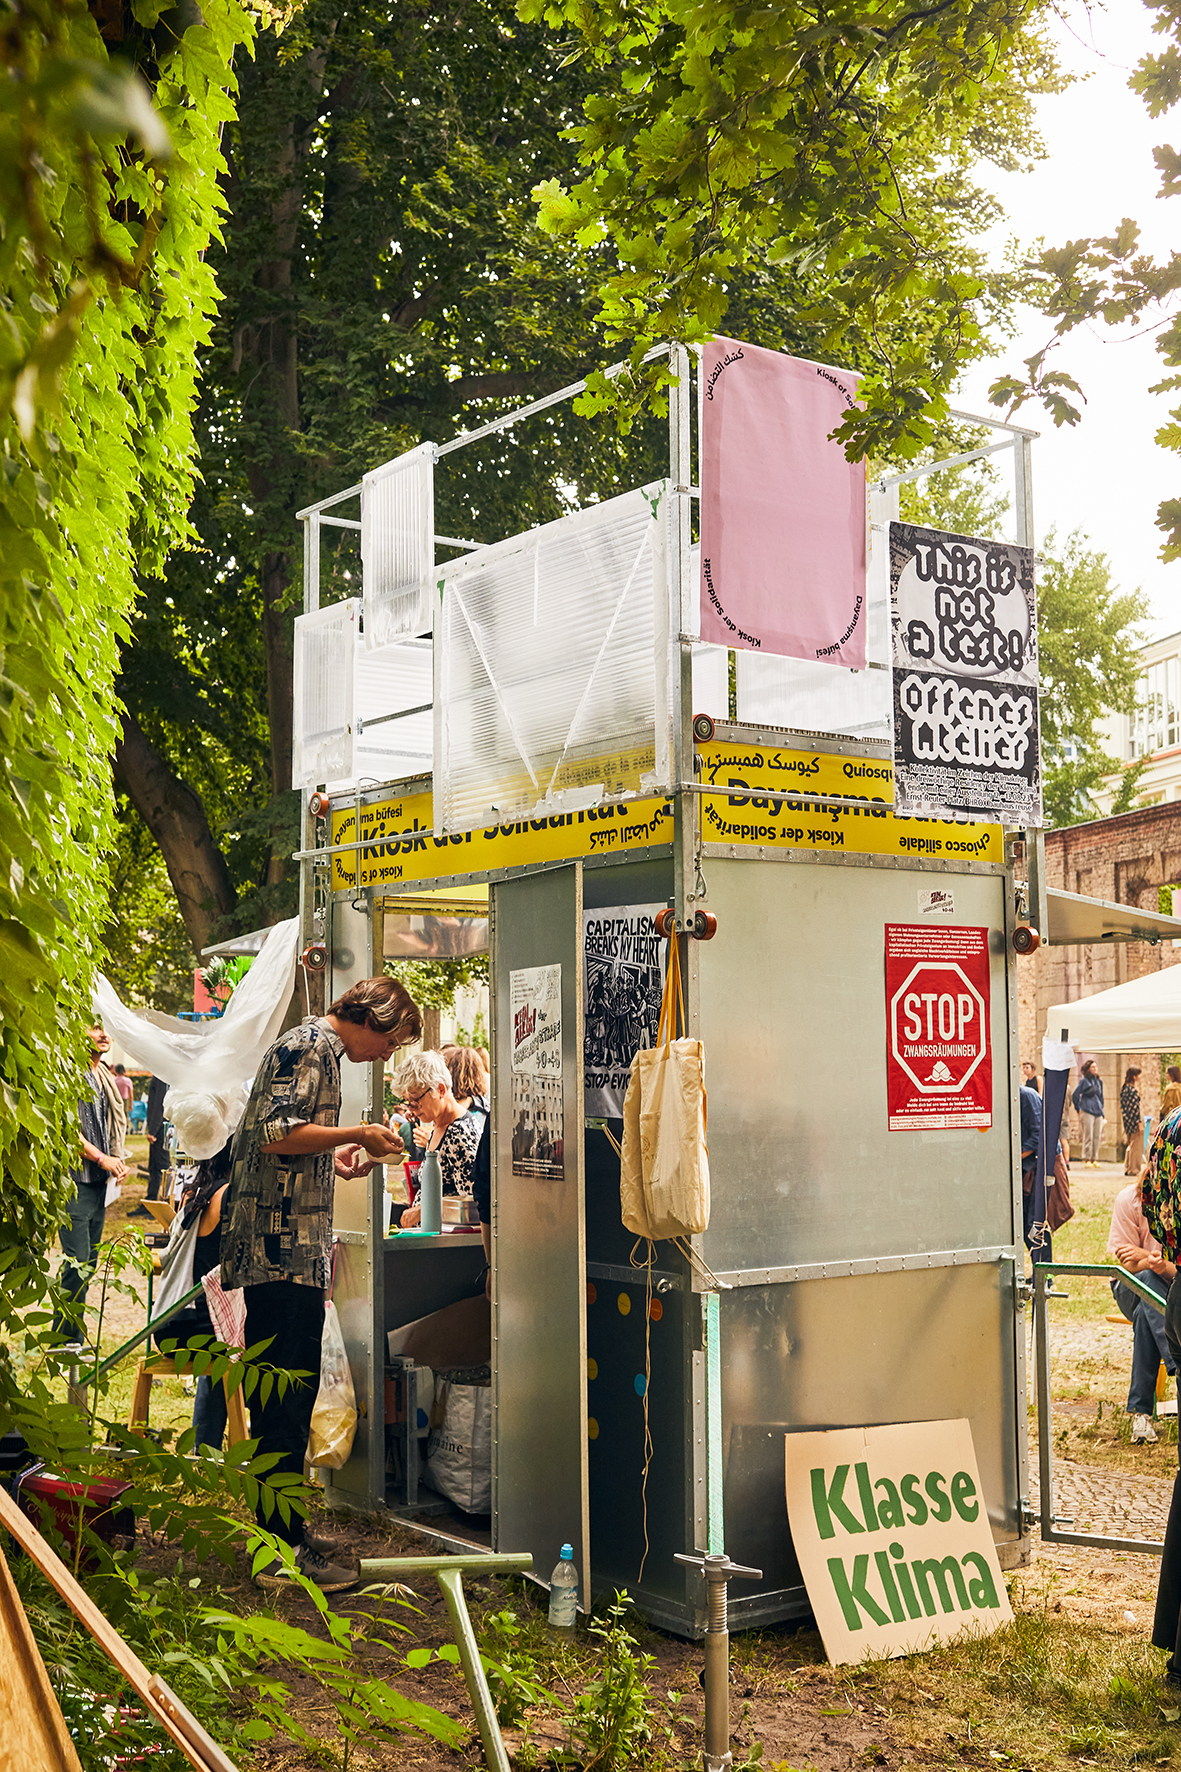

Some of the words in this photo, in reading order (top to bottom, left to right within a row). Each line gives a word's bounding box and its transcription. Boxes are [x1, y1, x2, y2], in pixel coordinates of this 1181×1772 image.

[723, 348, 744, 366] كشك
[705, 361, 725, 401] التضامن
[816, 368, 838, 387] Kiosk
[838, 384, 847, 394] of
[913, 541, 980, 588] This
[988, 554, 1014, 593] is
[703, 558, 725, 615] Solidarität
[937, 589, 993, 627] not
[722, 616, 737, 631] der
[737, 629, 762, 647] Kiosk
[910, 622, 933, 657] a
[941, 622, 1022, 668] test!
[903, 678, 1031, 728] Offenes
[914, 719, 1027, 766] Atelier
[900, 772, 915, 781] Eine
[957, 768, 982, 779] Zeichen
[335, 812, 375, 846] Dayanma
[704, 802, 777, 841] Solidarität
[780, 827, 804, 842] der
[363, 818, 428, 860] Kiosk
[590, 829, 618, 849] كشك
[807, 828, 844, 846] Kiosk
[899, 836, 942, 854] silidale
[946, 832, 990, 856] chiosco
[335, 858, 368, 885] Sidarity
[369, 868, 378, 882] of
[379, 865, 403, 880] Kiosk
[586, 916, 658, 936] CAPITALISM
[584, 935, 619, 957] BREAKS
[633, 936, 662, 967] HEART
[903, 992, 975, 1042] STOP
[903, 1042, 977, 1058] ZWANGSRÄUMUNGEN
[584, 1072, 609, 1089] STOP
[810, 1461, 979, 1540] Klasse
[826, 1541, 1001, 1632] Klima
